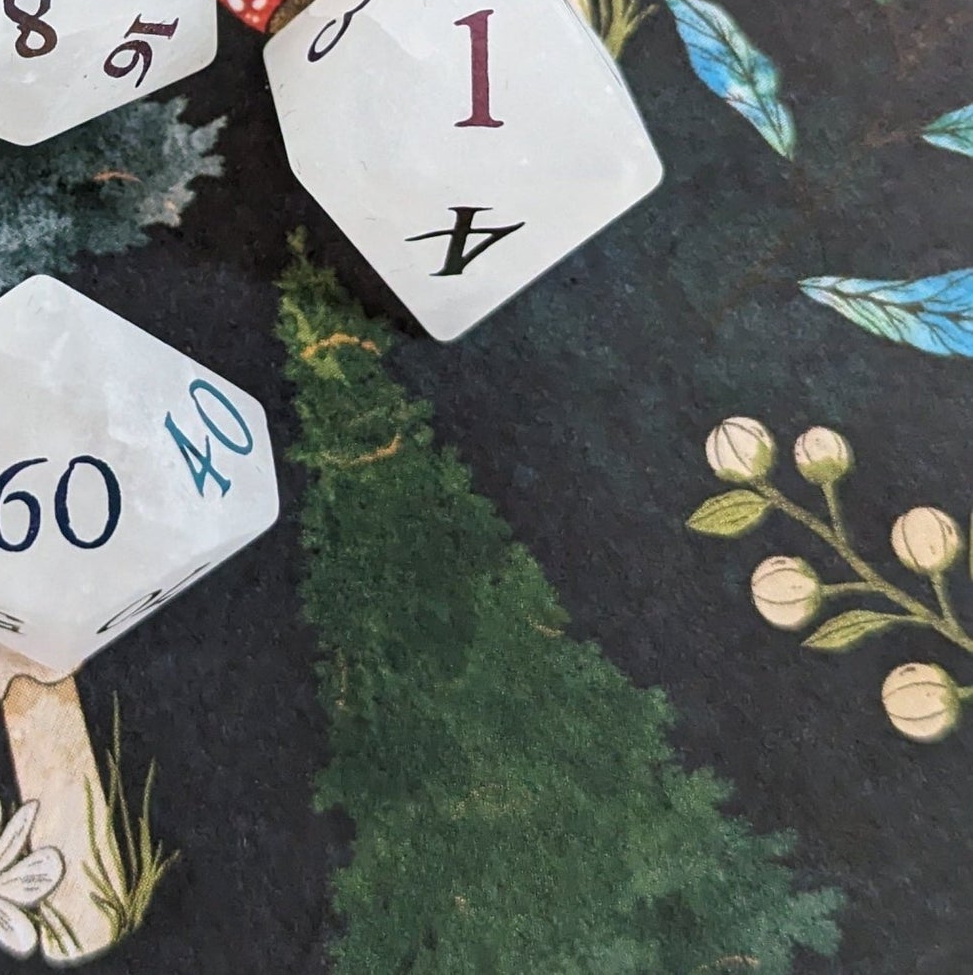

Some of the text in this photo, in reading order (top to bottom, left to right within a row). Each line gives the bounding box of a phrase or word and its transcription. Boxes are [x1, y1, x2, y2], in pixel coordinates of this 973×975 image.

[103, 13, 179, 88] 16
[454, 9, 504, 128] 1
[405, 206, 526, 277] 4
[164, 379, 253, 497] 40
